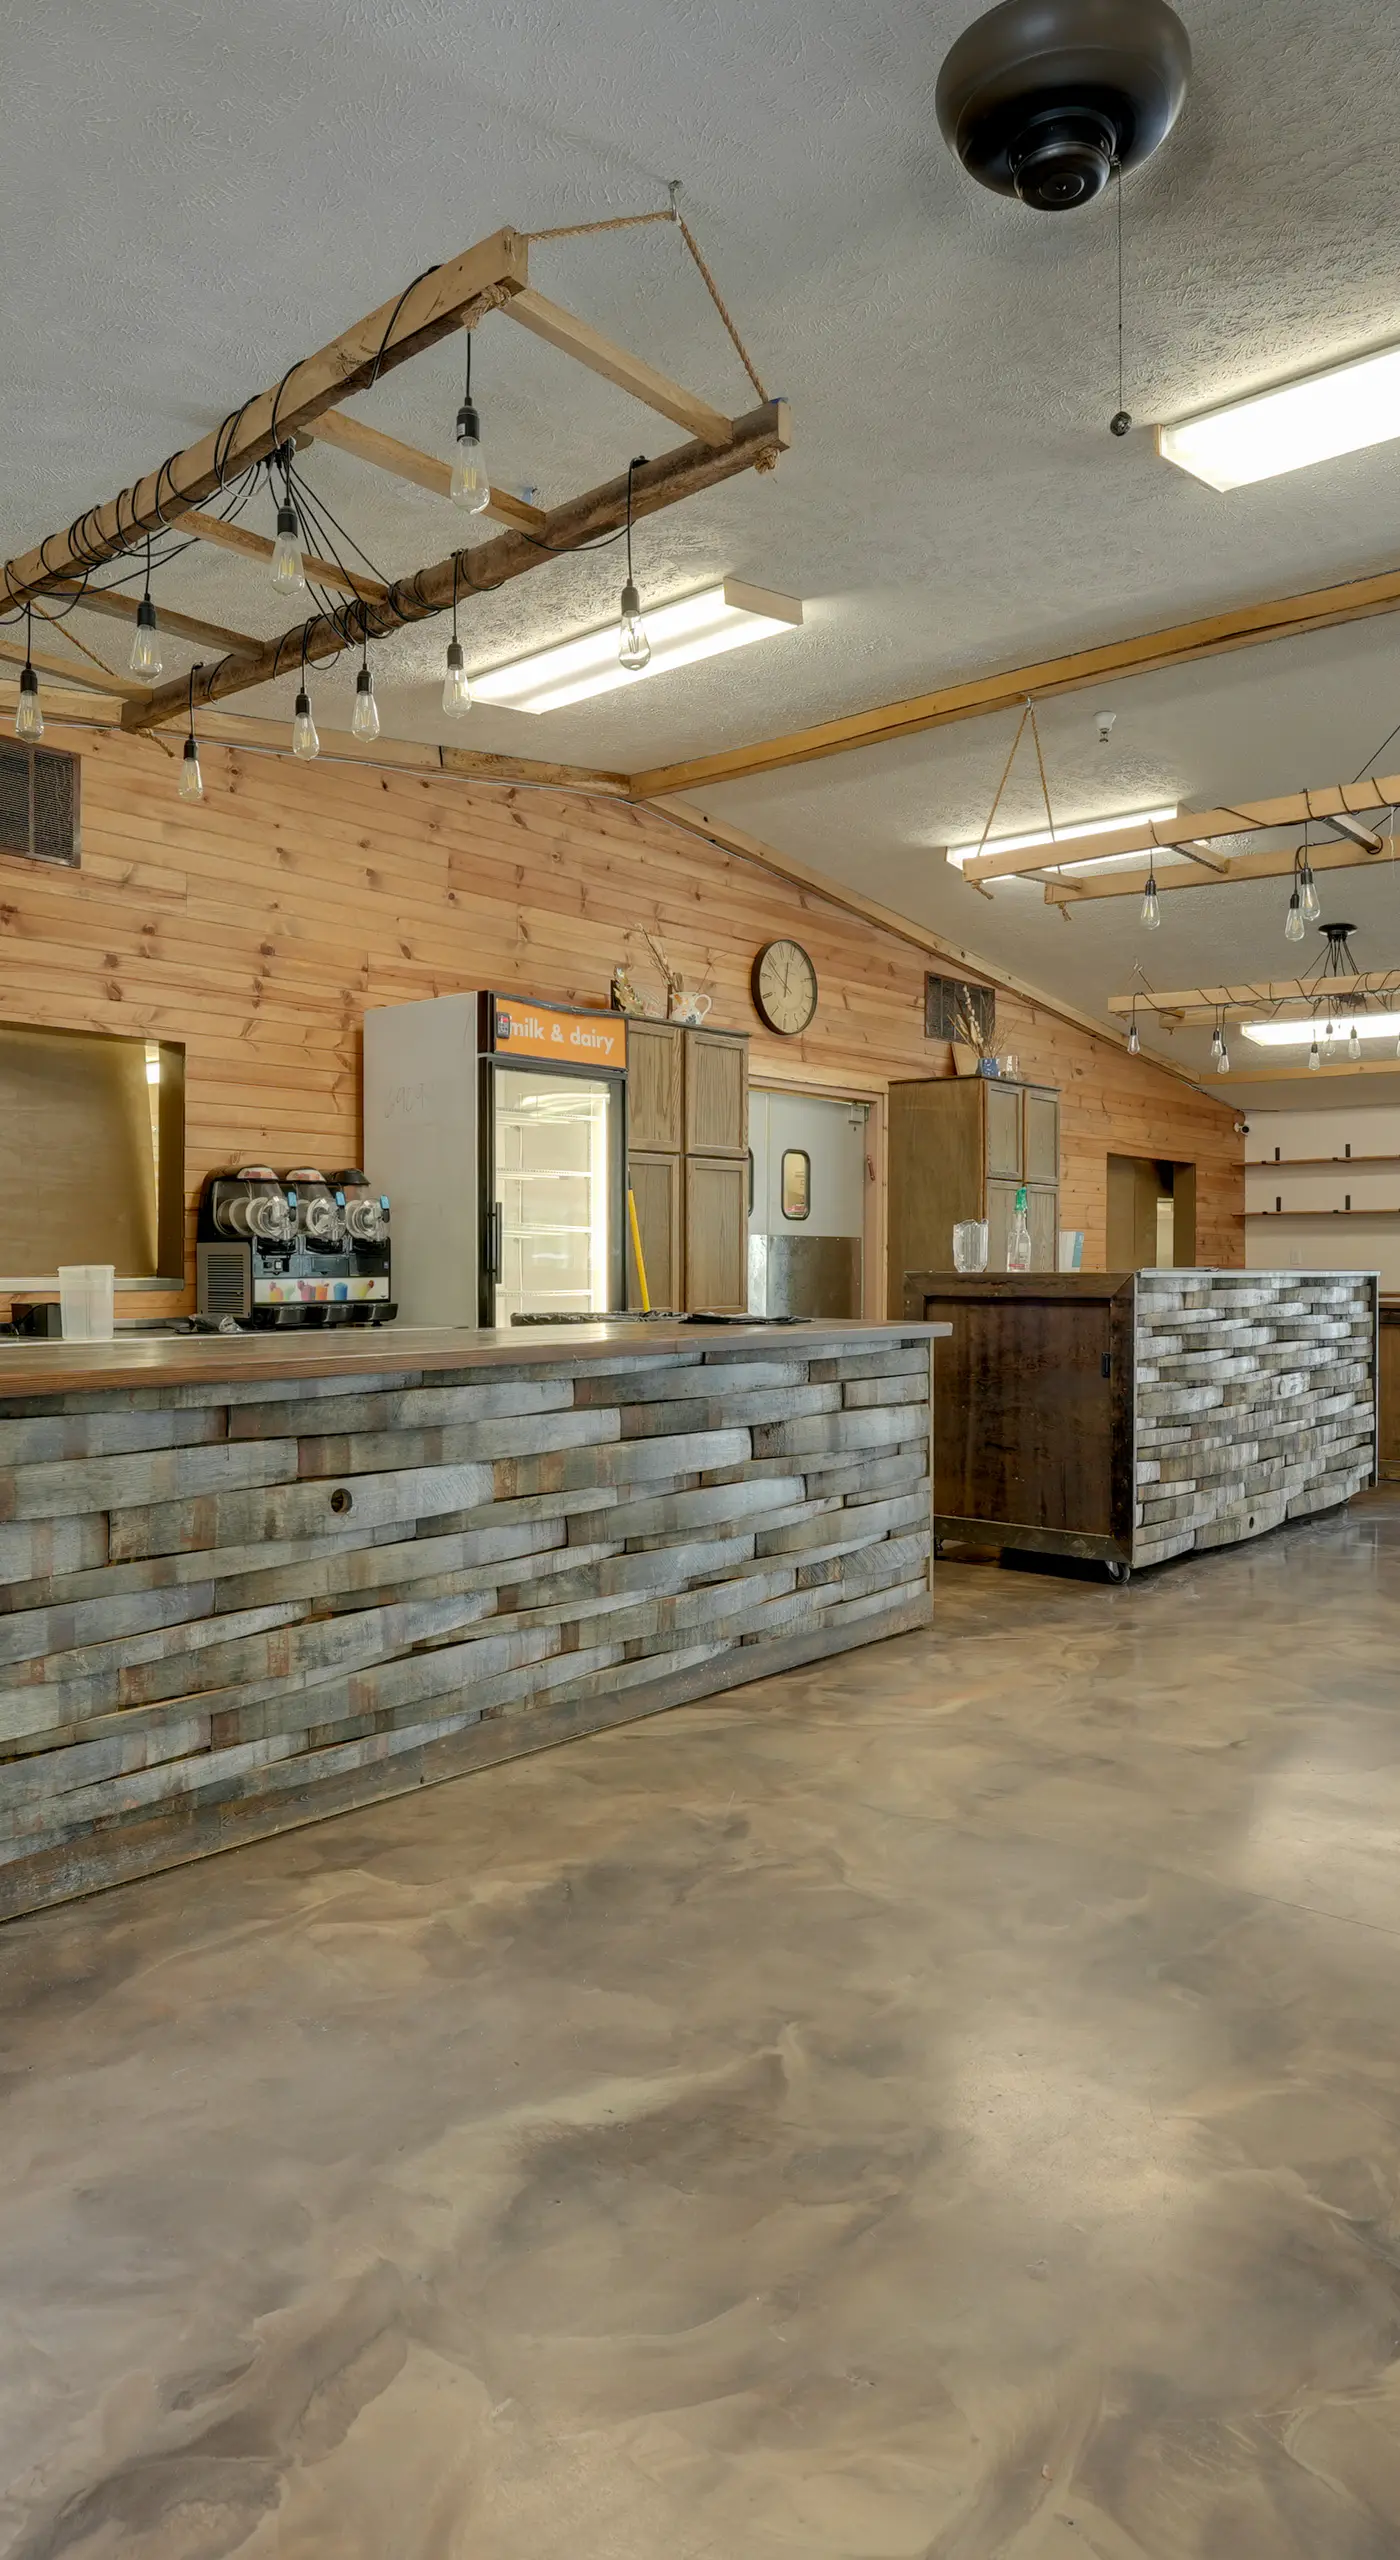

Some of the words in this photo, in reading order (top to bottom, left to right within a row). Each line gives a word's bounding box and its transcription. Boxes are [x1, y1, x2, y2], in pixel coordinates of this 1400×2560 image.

[510, 1016, 546, 1041] milk
[551, 1024, 565, 1044] &
[570, 1026, 615, 1055] dairy
